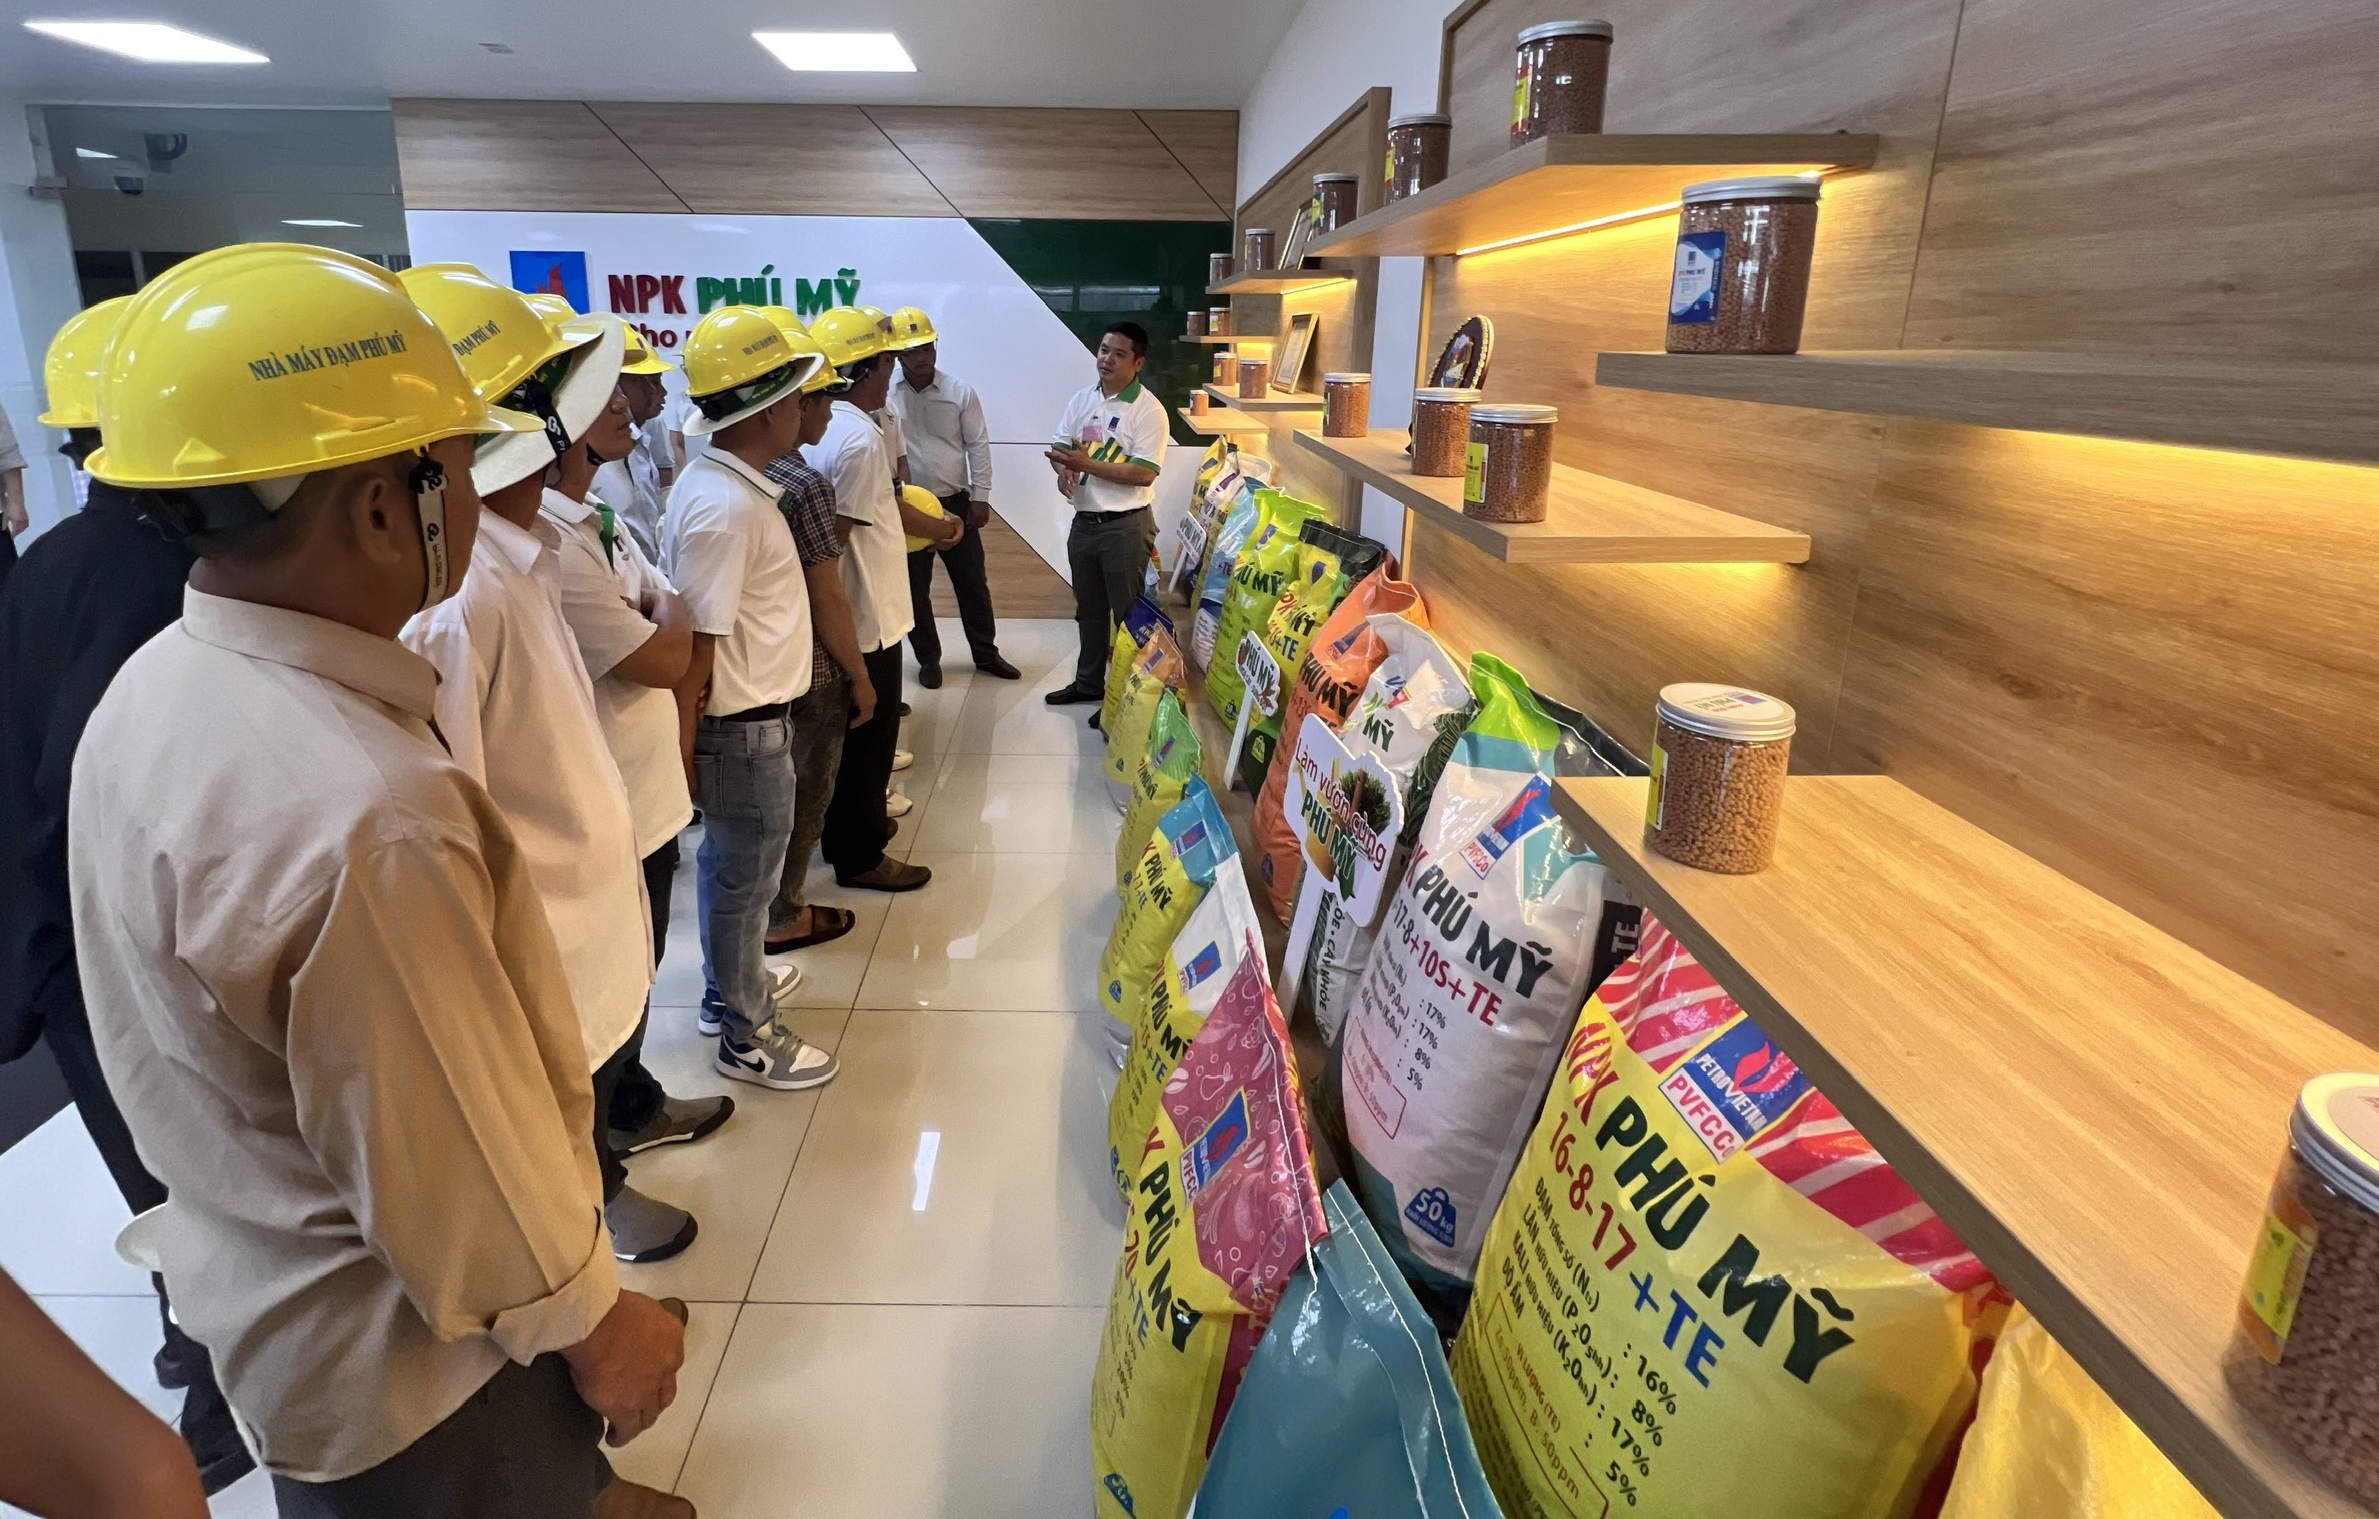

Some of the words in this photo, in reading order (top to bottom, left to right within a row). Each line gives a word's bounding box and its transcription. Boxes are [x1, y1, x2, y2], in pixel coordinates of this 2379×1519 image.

[608, 274, 687, 315] NPK
[697, 264, 783, 314] PHÚ
[796, 267, 861, 316] MỸ
[248, 351, 289, 381] NHÀ
[285, 345, 325, 374] MÁY
[323, 342, 362, 367] ĐẠM
[358, 331, 388, 359] PHÚ
[1316, 676, 1359, 718] MỸ
[1362, 714, 1394, 752] MỸ
[1295, 738, 1318, 782] Làm
[1350, 810, 1387, 872] cùng
[1301, 789, 1332, 846] PHÚ
[1330, 825, 1357, 880] MỸ
[1413, 864, 1479, 942] PHÚ
[1465, 920, 1555, 999] MỸ
[1414, 1048, 1431, 1070] 8%
[1418, 1022, 1438, 1050] 17%
[1425, 1002, 1446, 1029] 17%
[1407, 1067, 1423, 1091] 5%
[1140, 1160, 1180, 1266] PHÚ
[1550, 1111, 1637, 1271] 16-8-17
[1629, 1271, 1725, 1389] +TE
[1595, 1095, 1716, 1250] PHÚ
[1697, 1233, 1856, 1384] MỸ
[1148, 1257, 1203, 1353] MỸ
[1523, 1203, 1539, 1244] LÂN
[1545, 1267, 1563, 1301] HIỆU
[1631, 1400, 1663, 1447] 8%
[1535, 1176, 1553, 1221] ĐẠM
[1638, 1355, 1677, 1416] 16%
[1502, 1256, 1514, 1290] ĐỘ
[1606, 1460, 1637, 1507] 5%
[1513, 1230, 1529, 1275] KALI
[1536, 1300, 1554, 1334] HIỆU
[1611, 1416, 1649, 1477] 17%
[1543, 1402, 1561, 1433] (TE)
[1542, 1434, 1580, 1499] 50ppm
